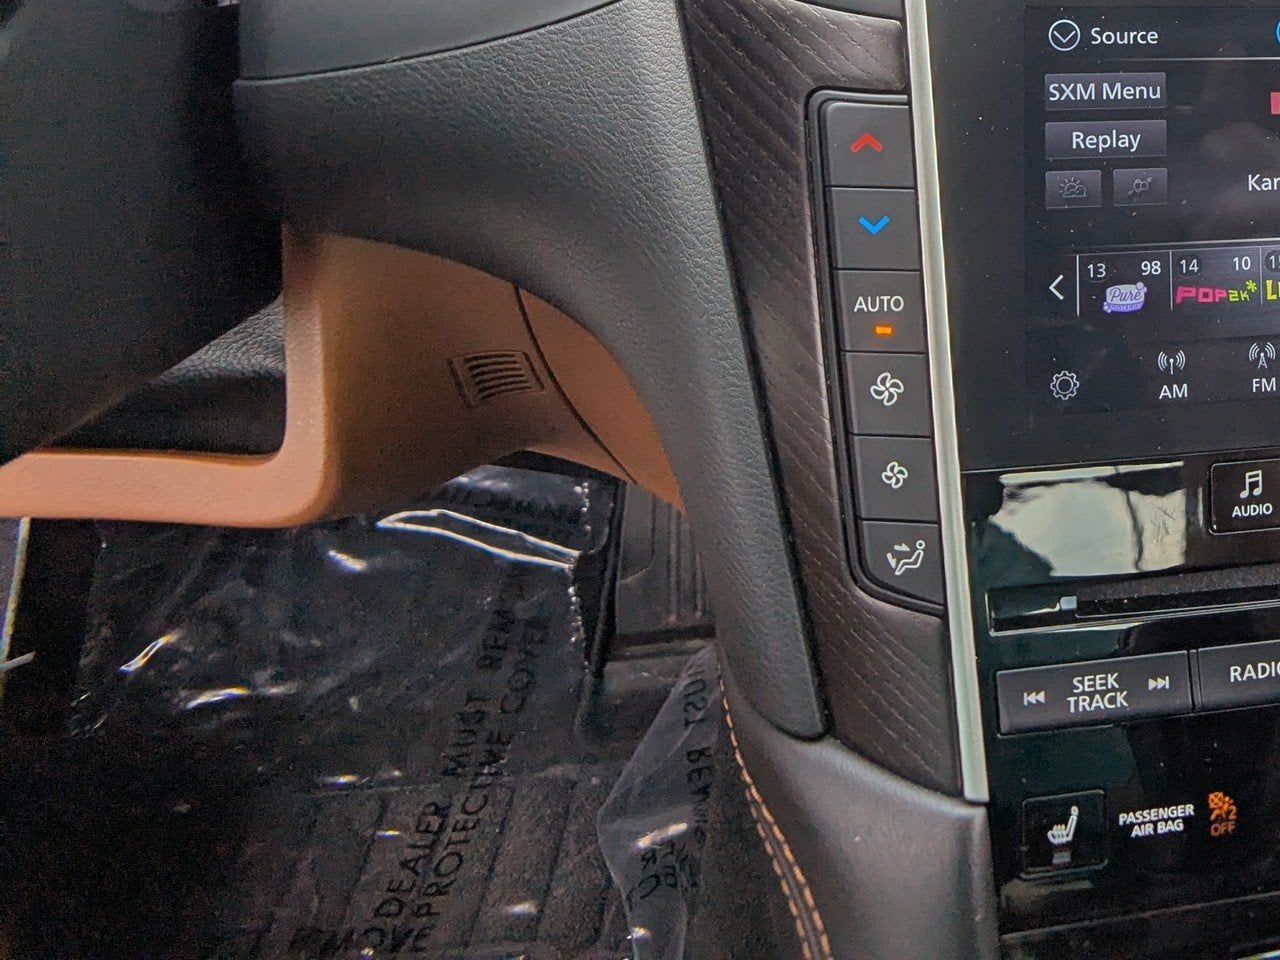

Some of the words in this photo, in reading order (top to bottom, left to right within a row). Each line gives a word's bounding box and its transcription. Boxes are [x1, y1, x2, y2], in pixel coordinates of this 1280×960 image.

[1091, 27, 1159, 45] Source
[1049, 82, 1096, 101] SXM
[1102, 82, 1162, 100] Menu
[1072, 129, 1141, 154] Replay
[1087, 262, 1106, 278] 13
[1141, 260, 1161, 276] 98
[1179, 258, 1199, 274] 14
[1233, 256, 1251, 271] 10
[855, 295, 904, 312] AUTO
[1109, 288, 1143, 303] Pure
[1158, 383, 1188, 400] AM
[1252, 377, 1276, 393] FM
[1231, 502, 1273, 518] AUDIO
[1072, 672, 1120, 693] SEEK
[1066, 690, 1129, 714] TRACK
[1118, 803, 1195, 826] PASSENGER
[1130, 824, 1154, 838] AIR
[1156, 819, 1184, 834] BAG
[1210, 821, 1237, 837] OFF
[374, 800, 450, 920] DEALER
